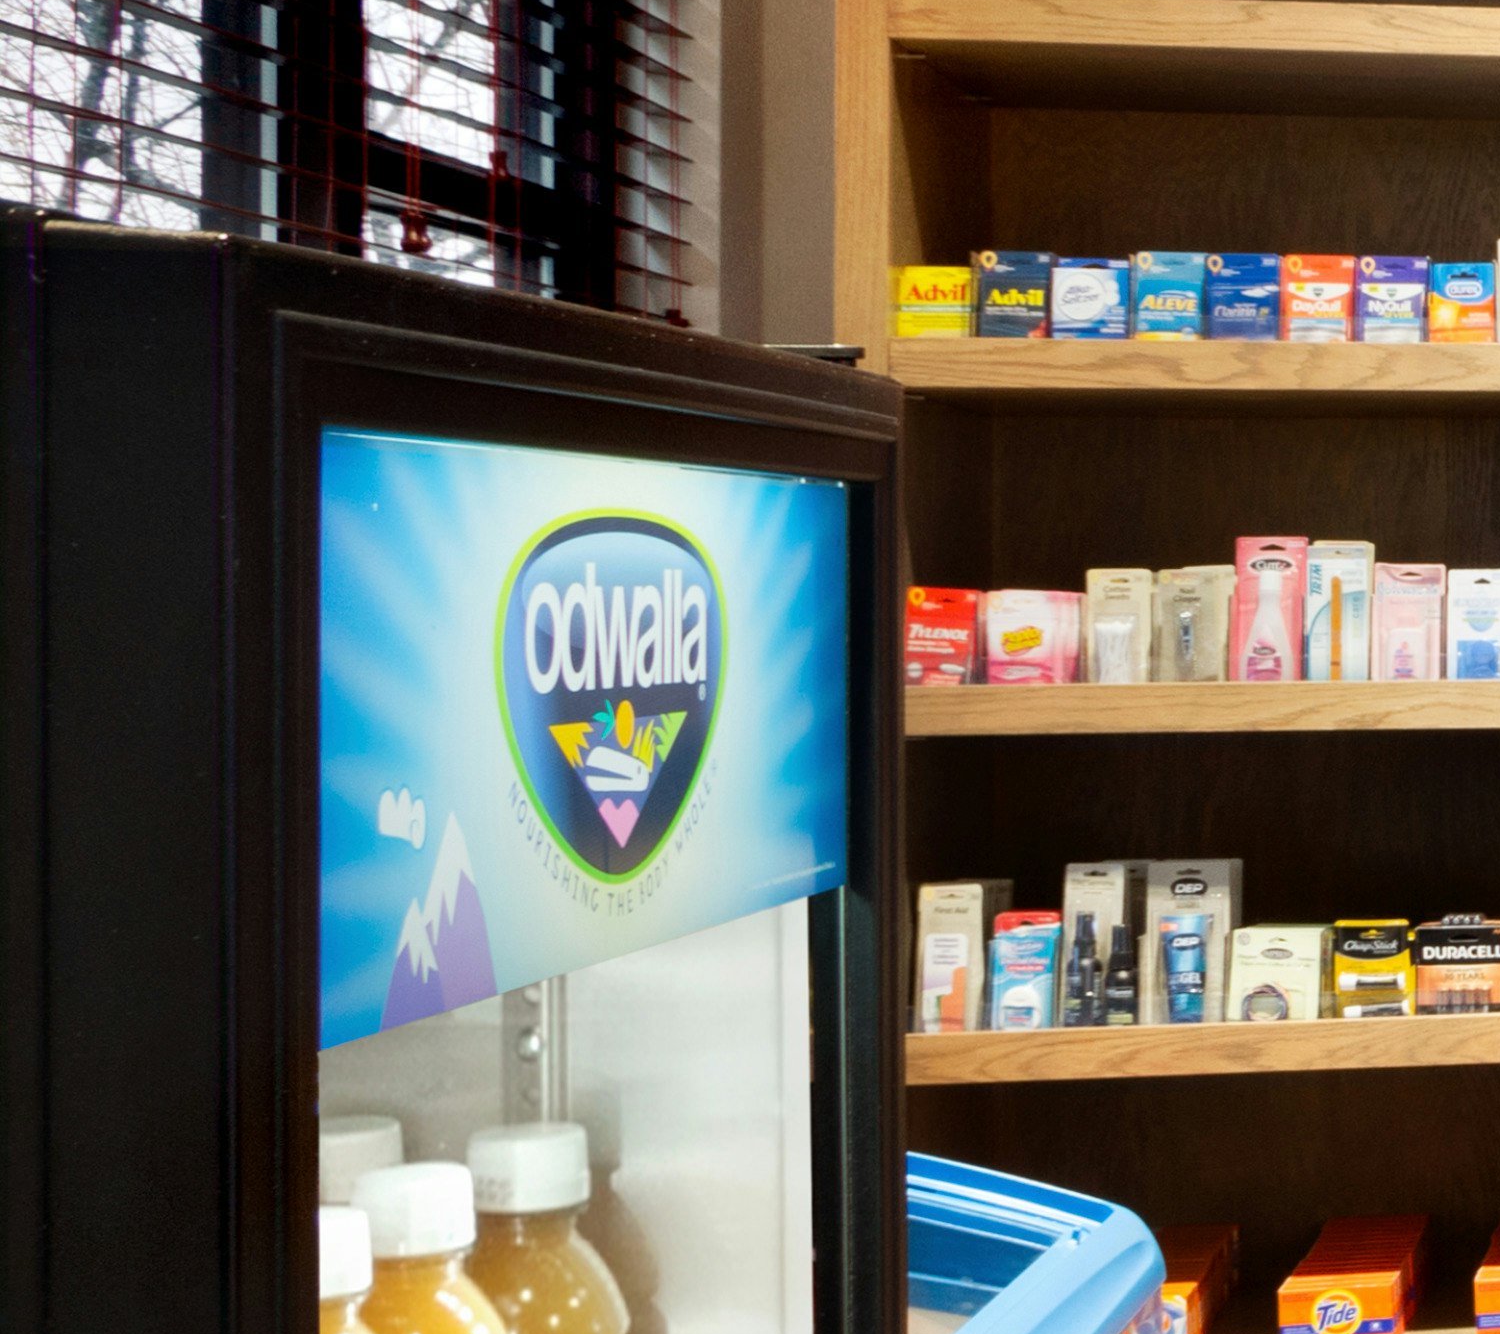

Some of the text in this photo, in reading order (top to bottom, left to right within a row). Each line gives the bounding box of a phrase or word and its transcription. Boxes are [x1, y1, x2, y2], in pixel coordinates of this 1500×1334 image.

[905, 282, 967, 303] Advil
[986, 288, 1046, 307] Advil
[1139, 295, 1198, 312] ALEVE
[1291, 300, 1342, 316] DayQuil
[1367, 300, 1412, 315] NyQuil
[1308, 563, 1323, 596] TRIM
[524, 562, 708, 695] odwalla
[908, 624, 969, 641] TYLENOL
[505, 778, 600, 913] NOURISHING
[607, 891, 635, 917] THE
[1173, 881, 1204, 895] DEP
[1171, 936, 1200, 949] DEP
[1343, 940, 1399, 954] ChapStick
[1316, 1302, 1358, 1331] Tide
